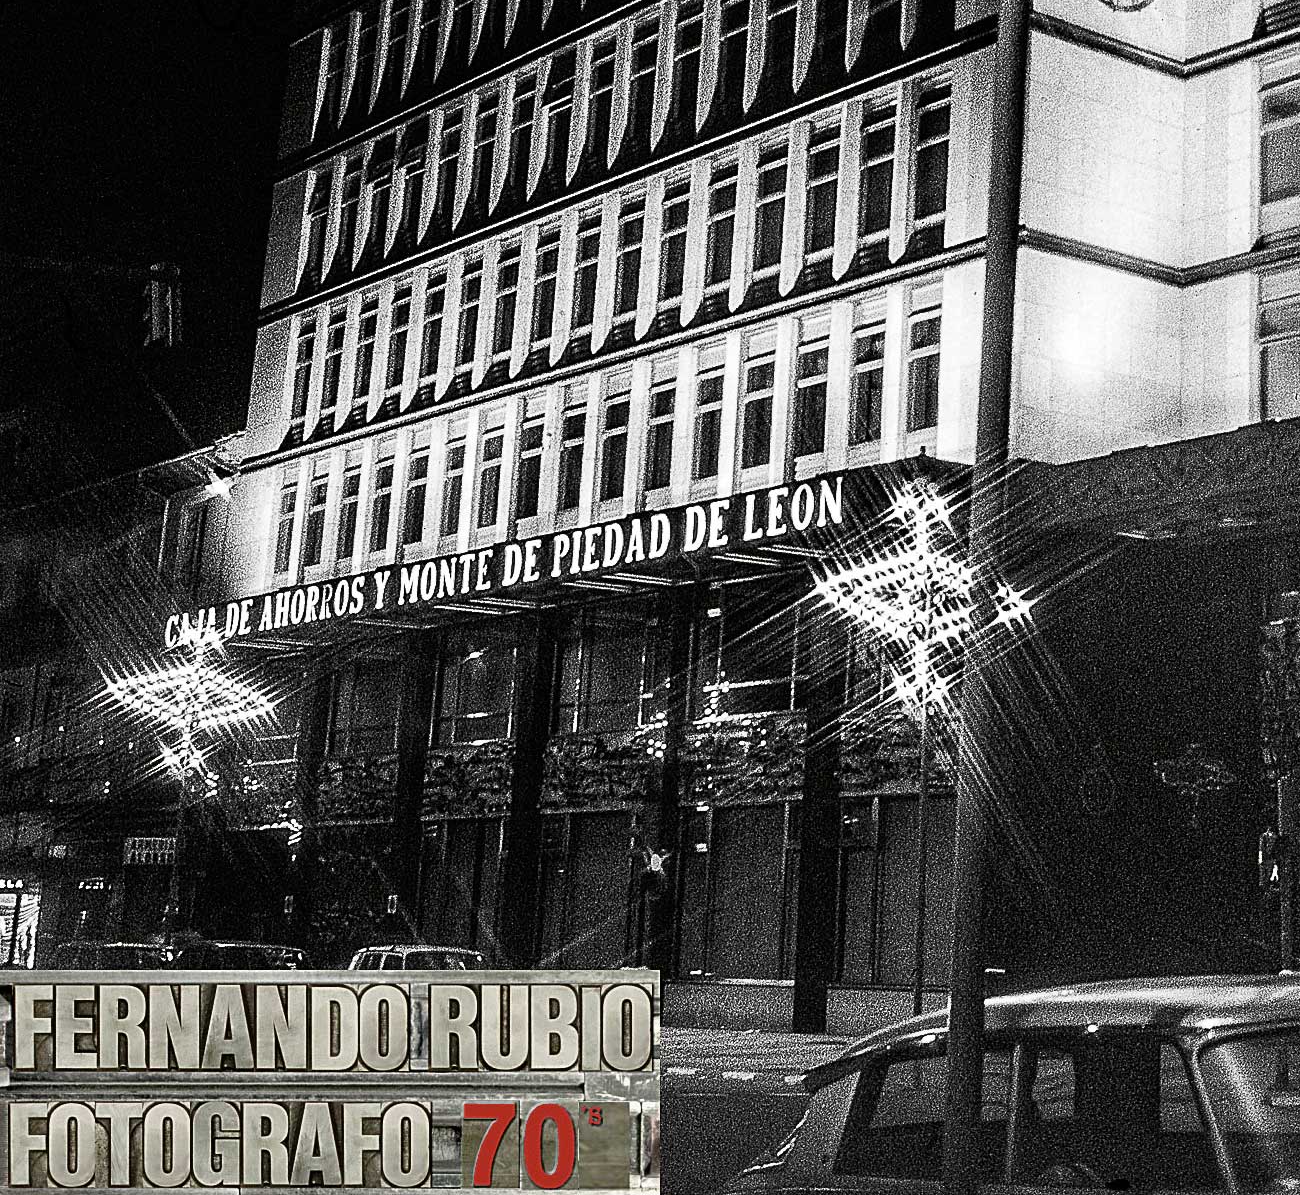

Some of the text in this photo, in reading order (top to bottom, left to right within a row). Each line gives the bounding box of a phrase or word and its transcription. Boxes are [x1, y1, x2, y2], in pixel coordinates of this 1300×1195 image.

[225, 600, 253, 637] DE
[258, 577, 365, 632] AHORROS
[374, 570, 391, 609] Y
[399, 549, 494, 604] MONTE
[502, 539, 542, 586] DE
[551, 514, 671, 577] PIEDAD
[684, 500, 730, 552] DE
[743, 477, 843, 541] LEON
